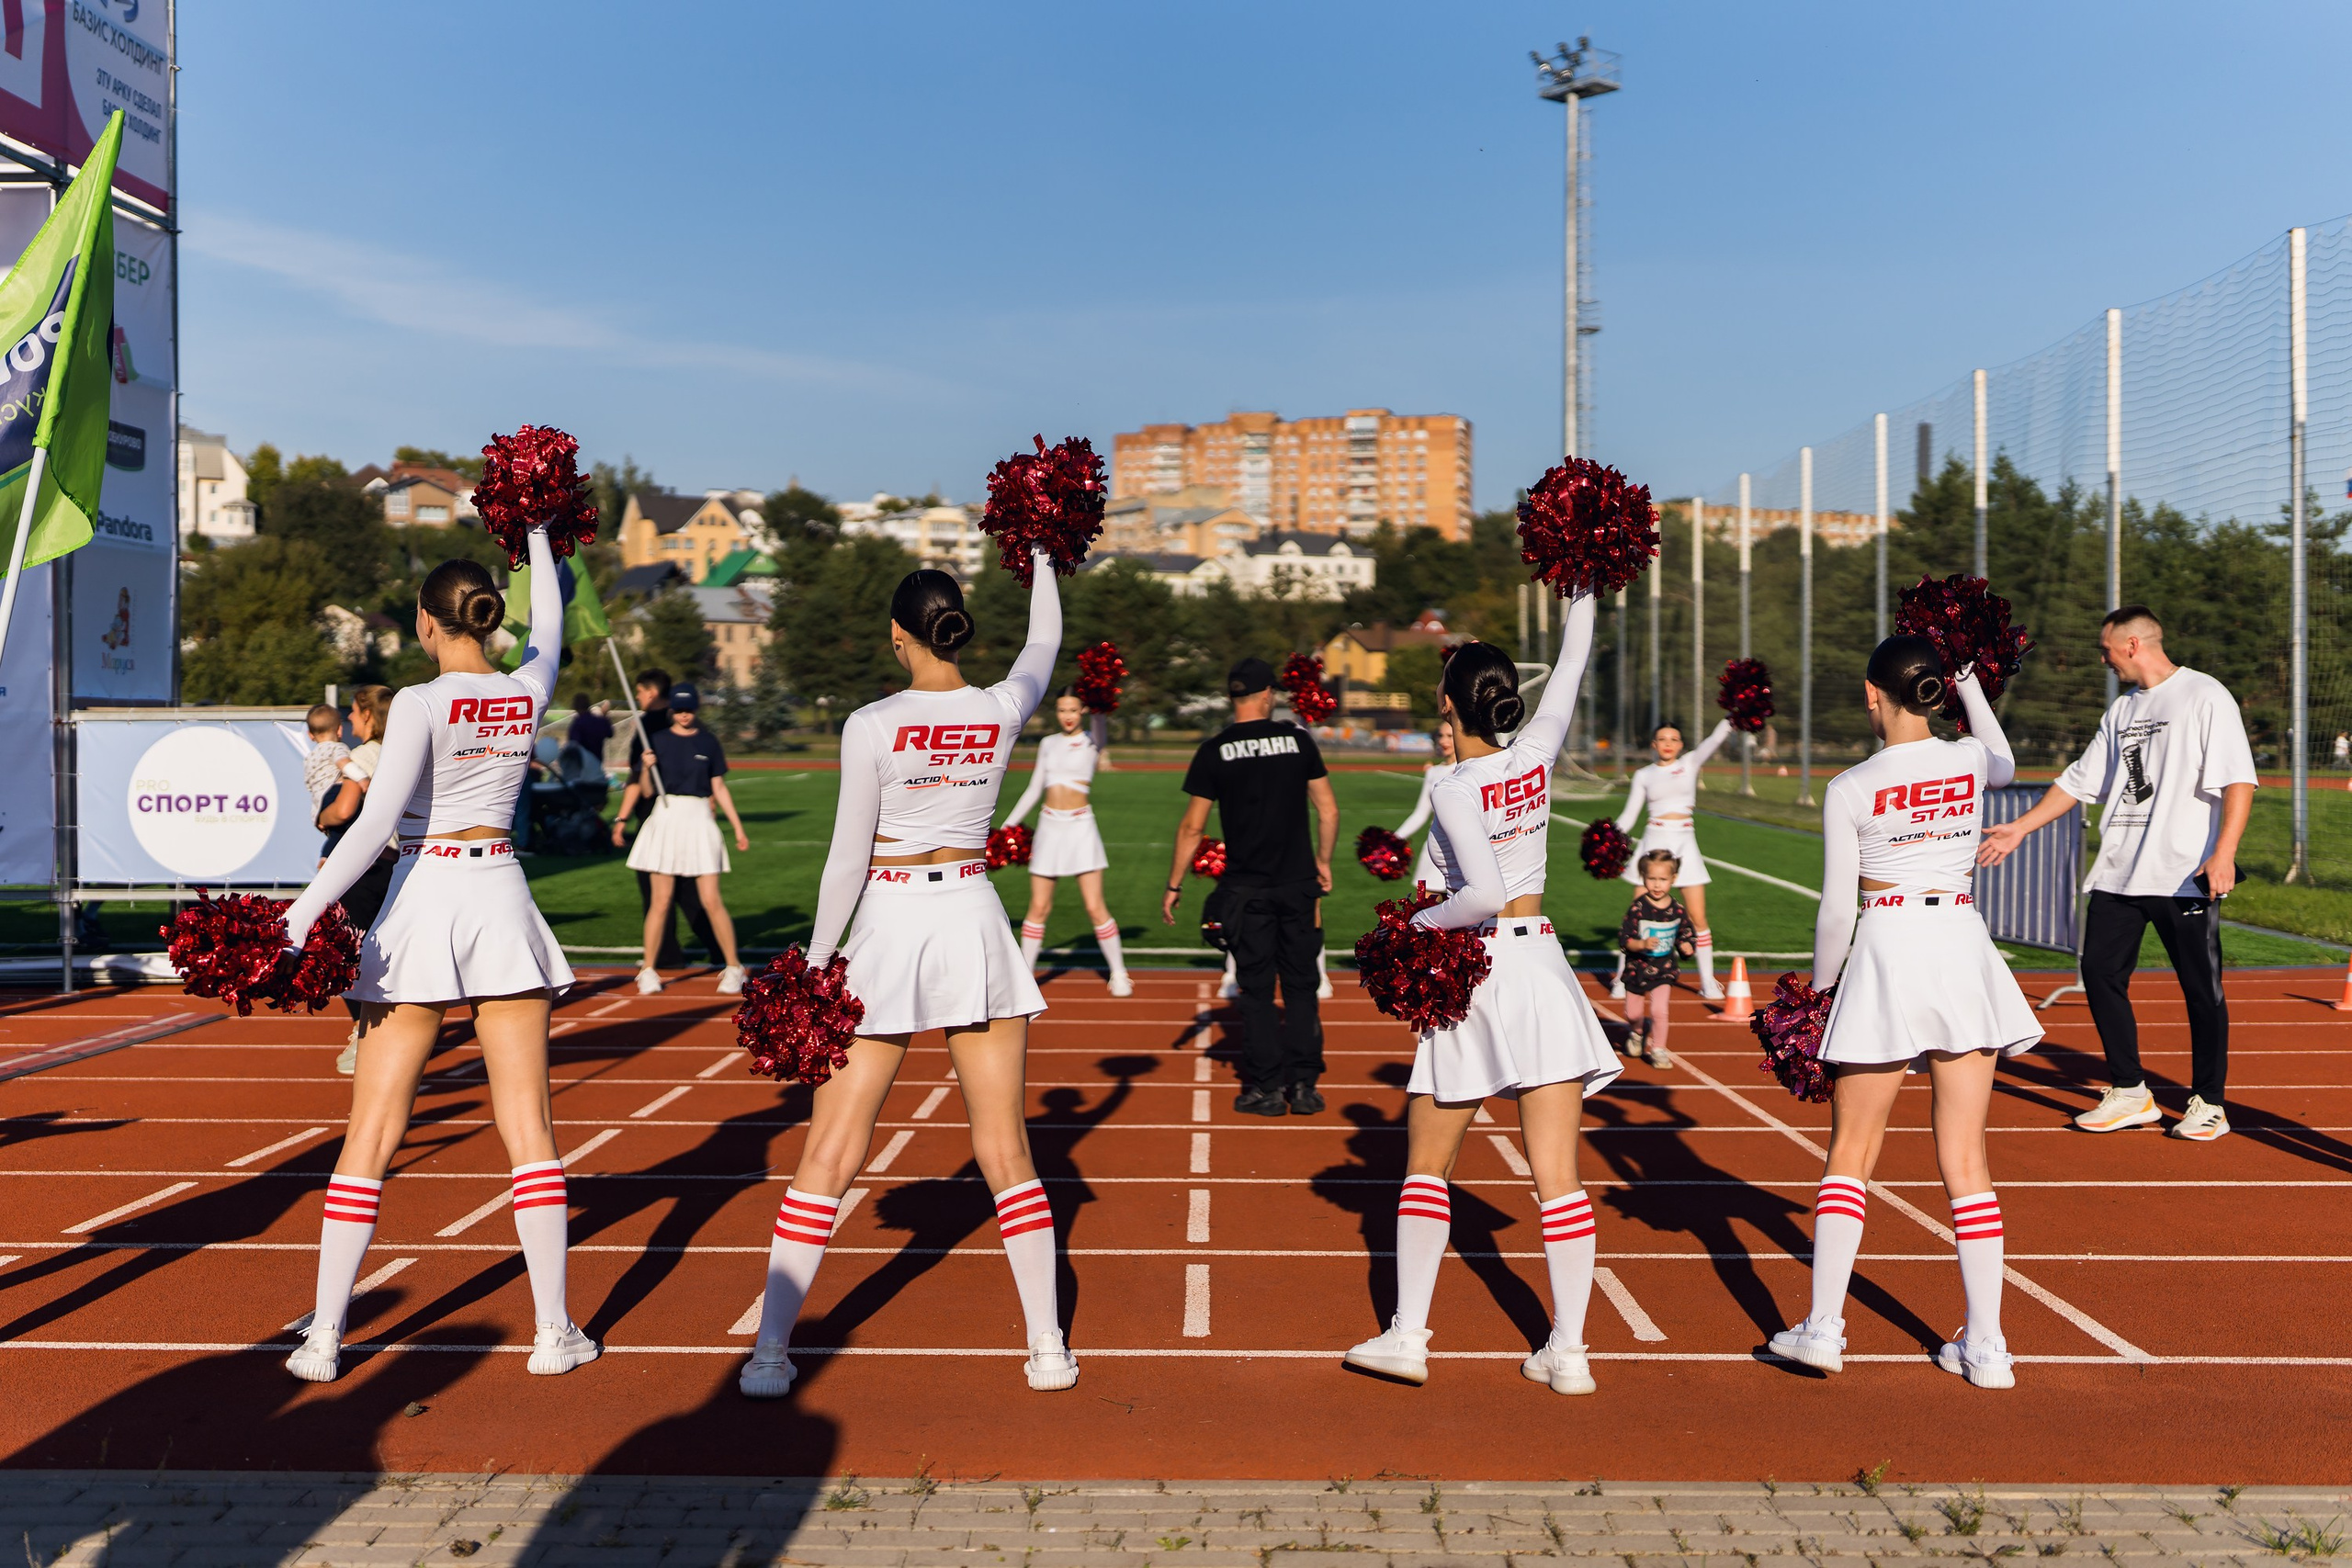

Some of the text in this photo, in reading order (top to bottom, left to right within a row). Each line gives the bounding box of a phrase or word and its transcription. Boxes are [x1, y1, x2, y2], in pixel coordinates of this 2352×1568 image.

[73, 2, 164, 75] БАЗИС ХОЛДИНГ
[96, 68, 162, 119] ЭТУ АРКУ СДЕЛАЛ
[113, 250, 151, 287] БЕР
[96, 509, 153, 542] Pandora
[448, 695, 534, 726] RED
[476, 723, 533, 739] STAR
[892, 724, 1001, 752] RED
[452, 745, 494, 757] ACTION
[928, 751, 995, 767] STAR
[1219, 736, 1300, 761] ОХРАНА
[136, 779, 170, 792] PRO
[903, 773, 989, 787] ACTION TEAM
[1480, 764, 1545, 812] RED
[138, 794, 268, 813] СПОРТ 40
[1872, 773, 1974, 817] RED
[1505, 793, 1546, 821] STAR
[1910, 802, 1973, 824] STAR
[1489, 820, 1546, 840] ACTION TEAM
[1888, 829, 1972, 843] ACTION TEAM
[401, 844, 462, 859] STAR
[867, 869, 911, 884] TAR
